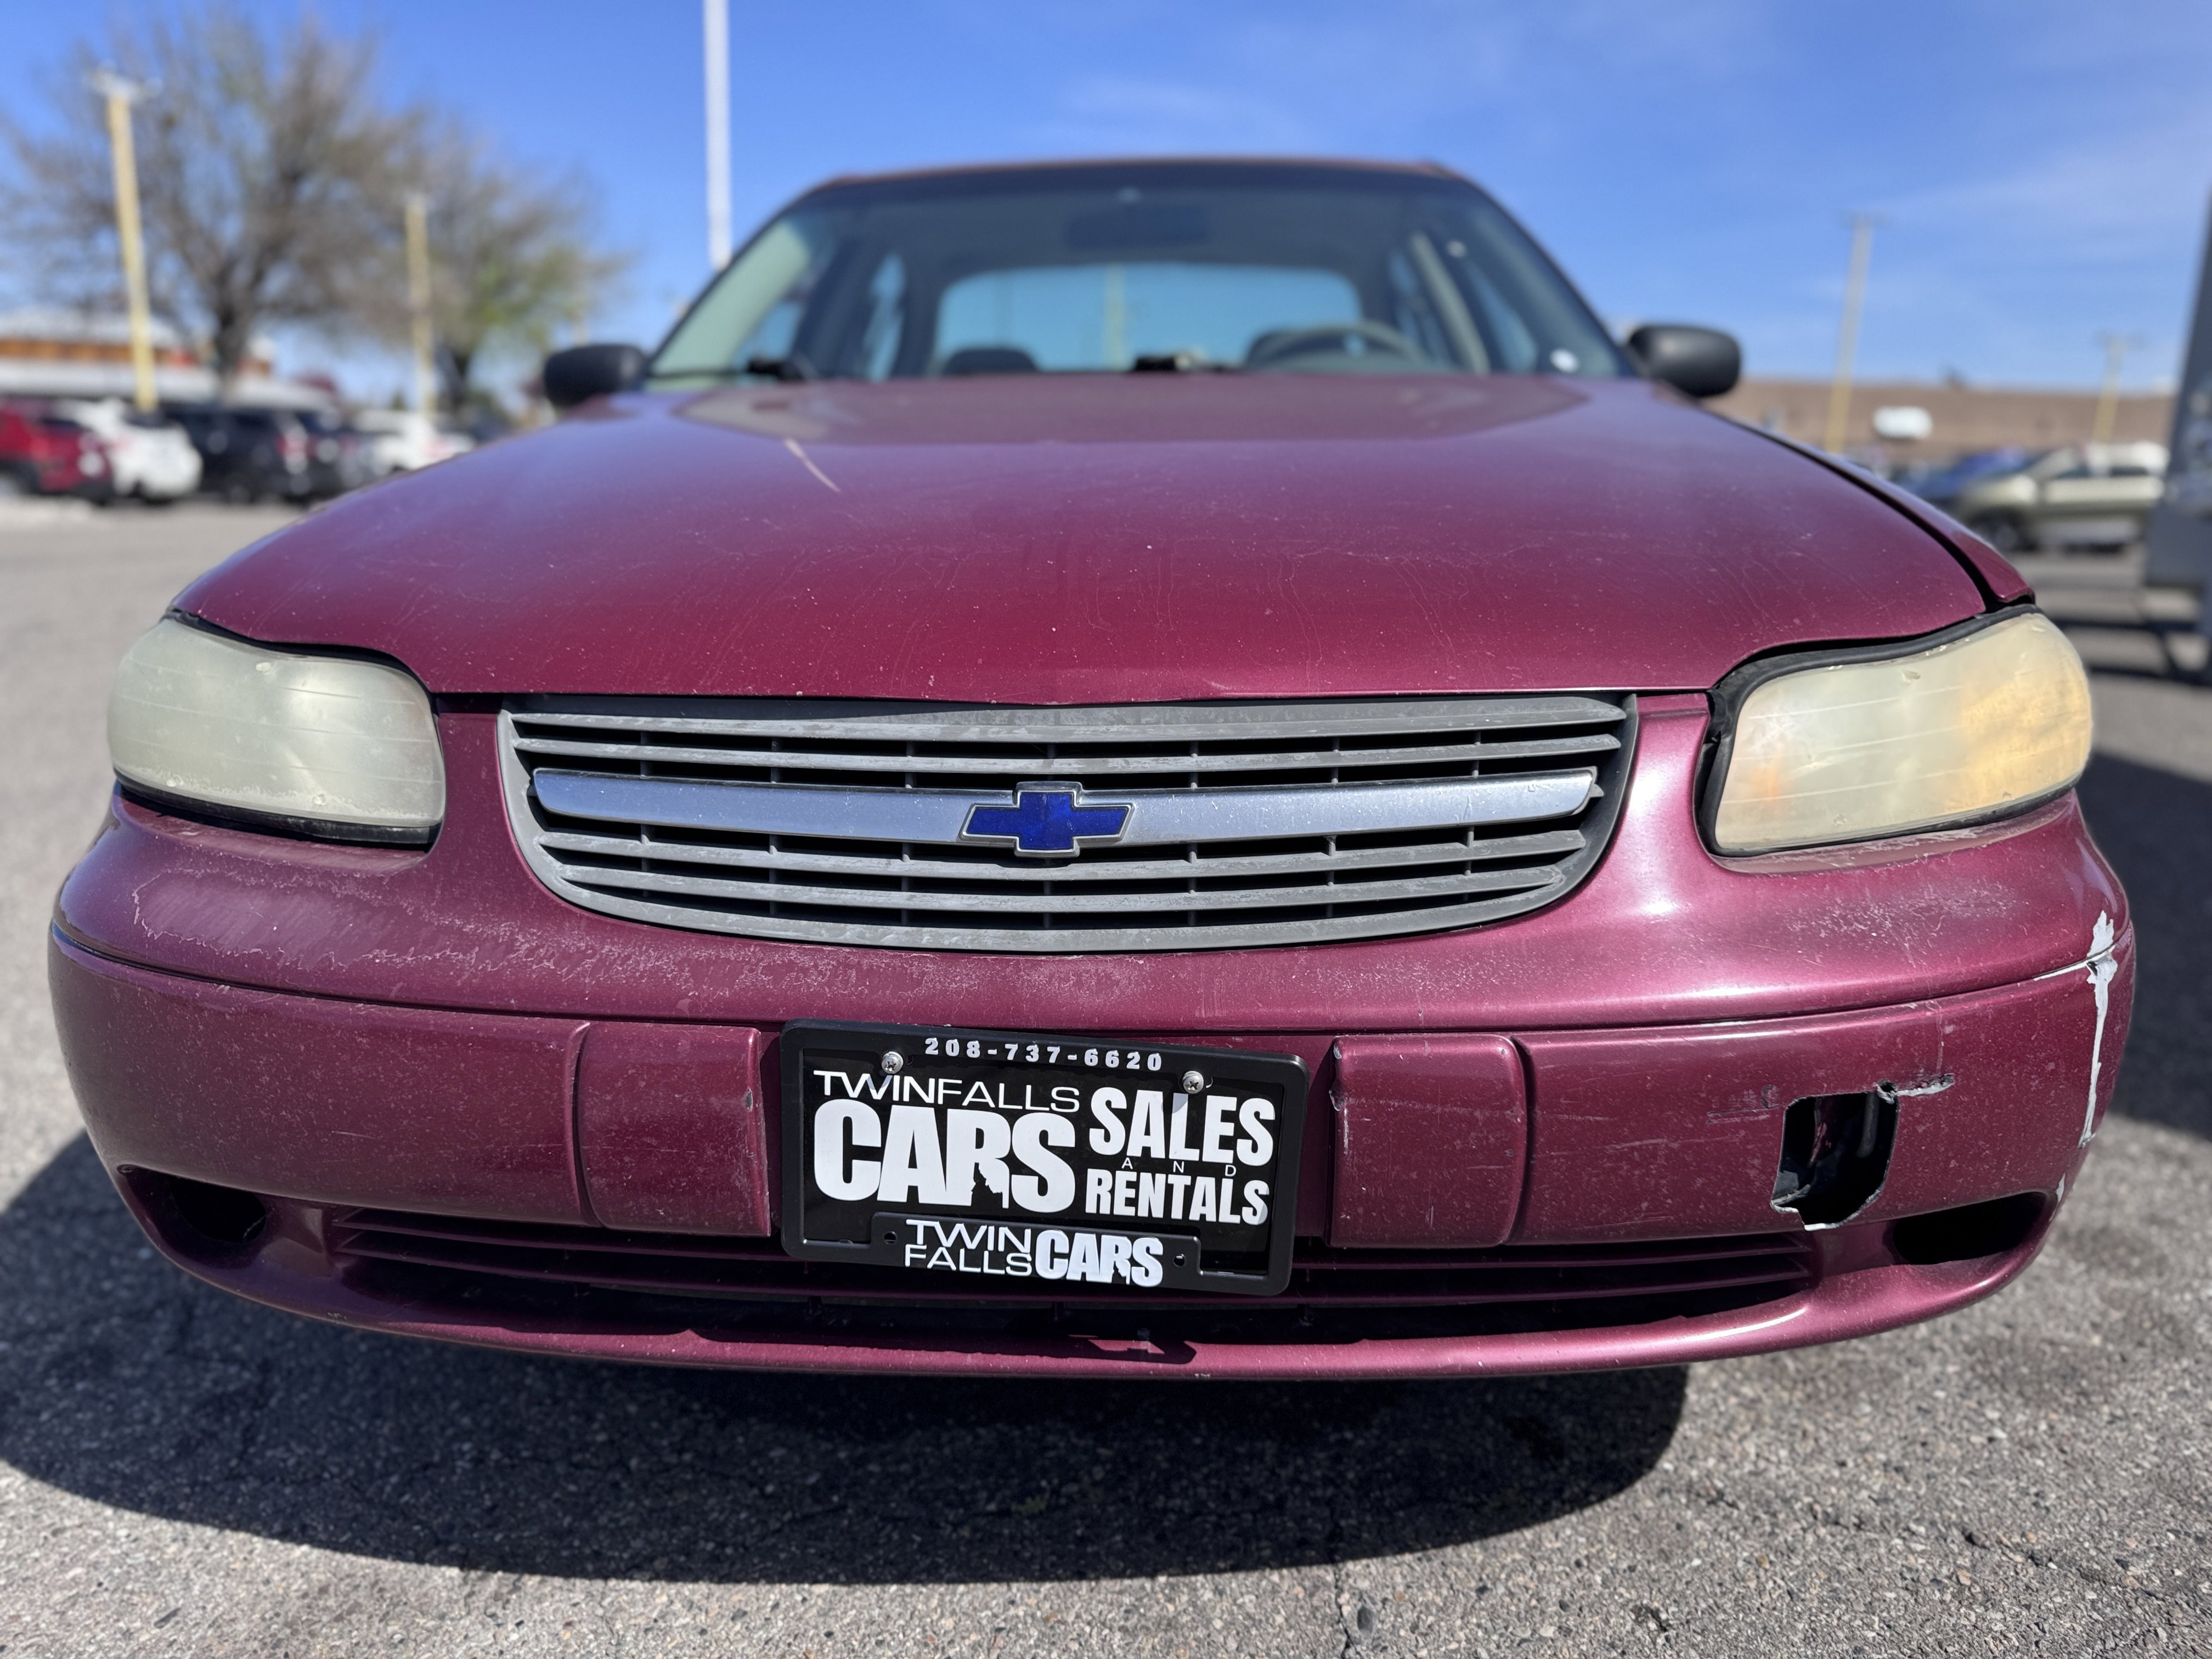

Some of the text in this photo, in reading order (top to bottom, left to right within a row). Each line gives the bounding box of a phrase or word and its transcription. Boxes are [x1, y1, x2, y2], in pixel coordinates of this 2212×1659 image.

[925, 1038, 1161, 1071] 208-737-6620
[1088, 1087, 1276, 1166] SALES
[814, 1098, 1075, 1213] CARS
[1086, 1171, 1269, 1225] RENTALS
[905, 1246, 1032, 1276] FALLS
[906, 1219, 1031, 1255] TWIN
[1035, 1229, 1163, 1287] CARS
